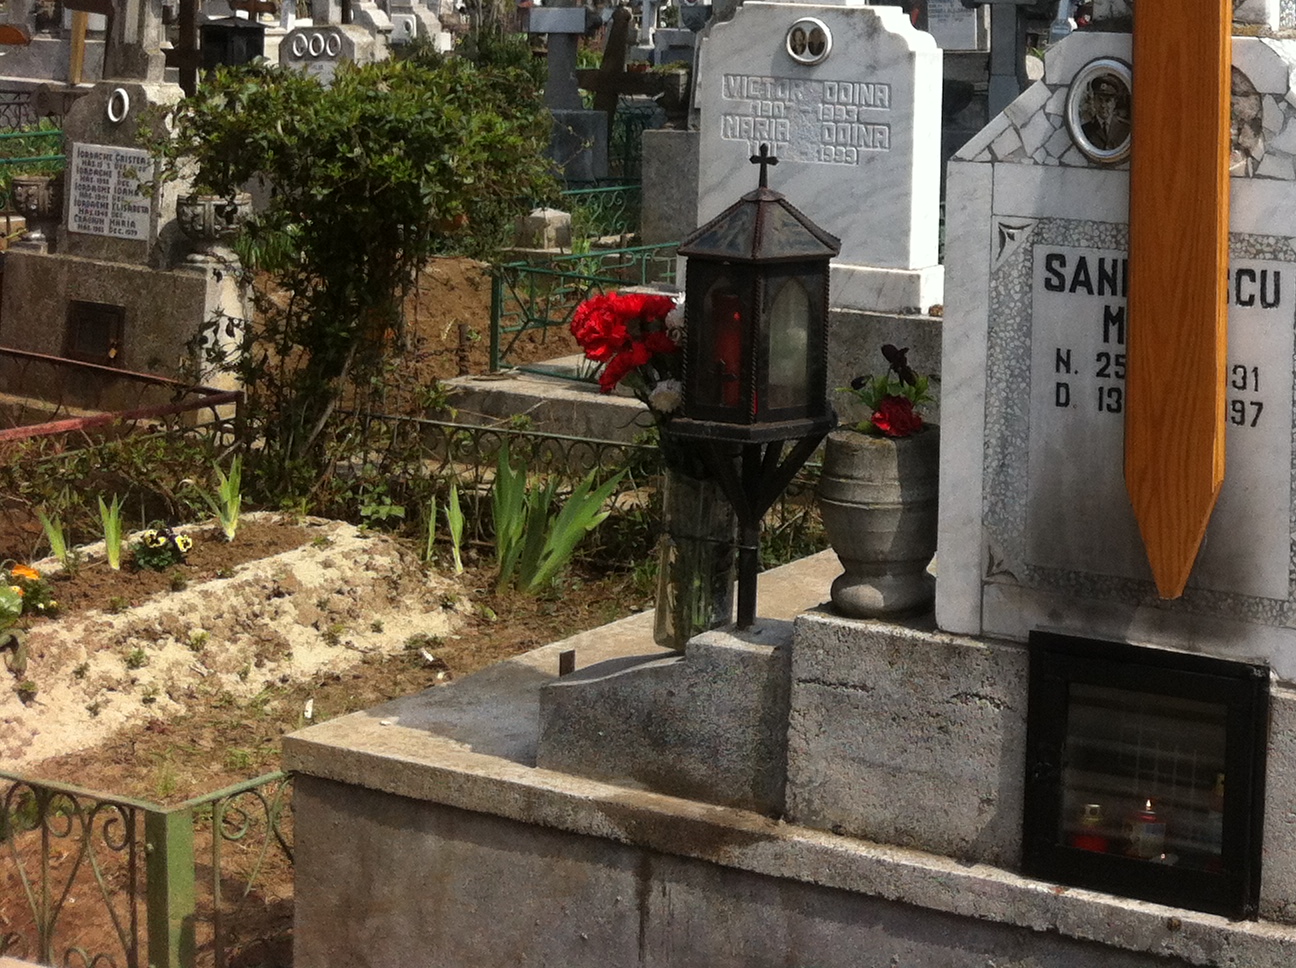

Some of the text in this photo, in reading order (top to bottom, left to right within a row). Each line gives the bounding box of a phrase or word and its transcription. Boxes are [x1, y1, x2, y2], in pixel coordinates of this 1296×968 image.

[727, 75, 890, 107] VICTOR DOINA
[725, 115, 890, 149] MARIA DOINA
[1055, 348, 1079, 375] N.
